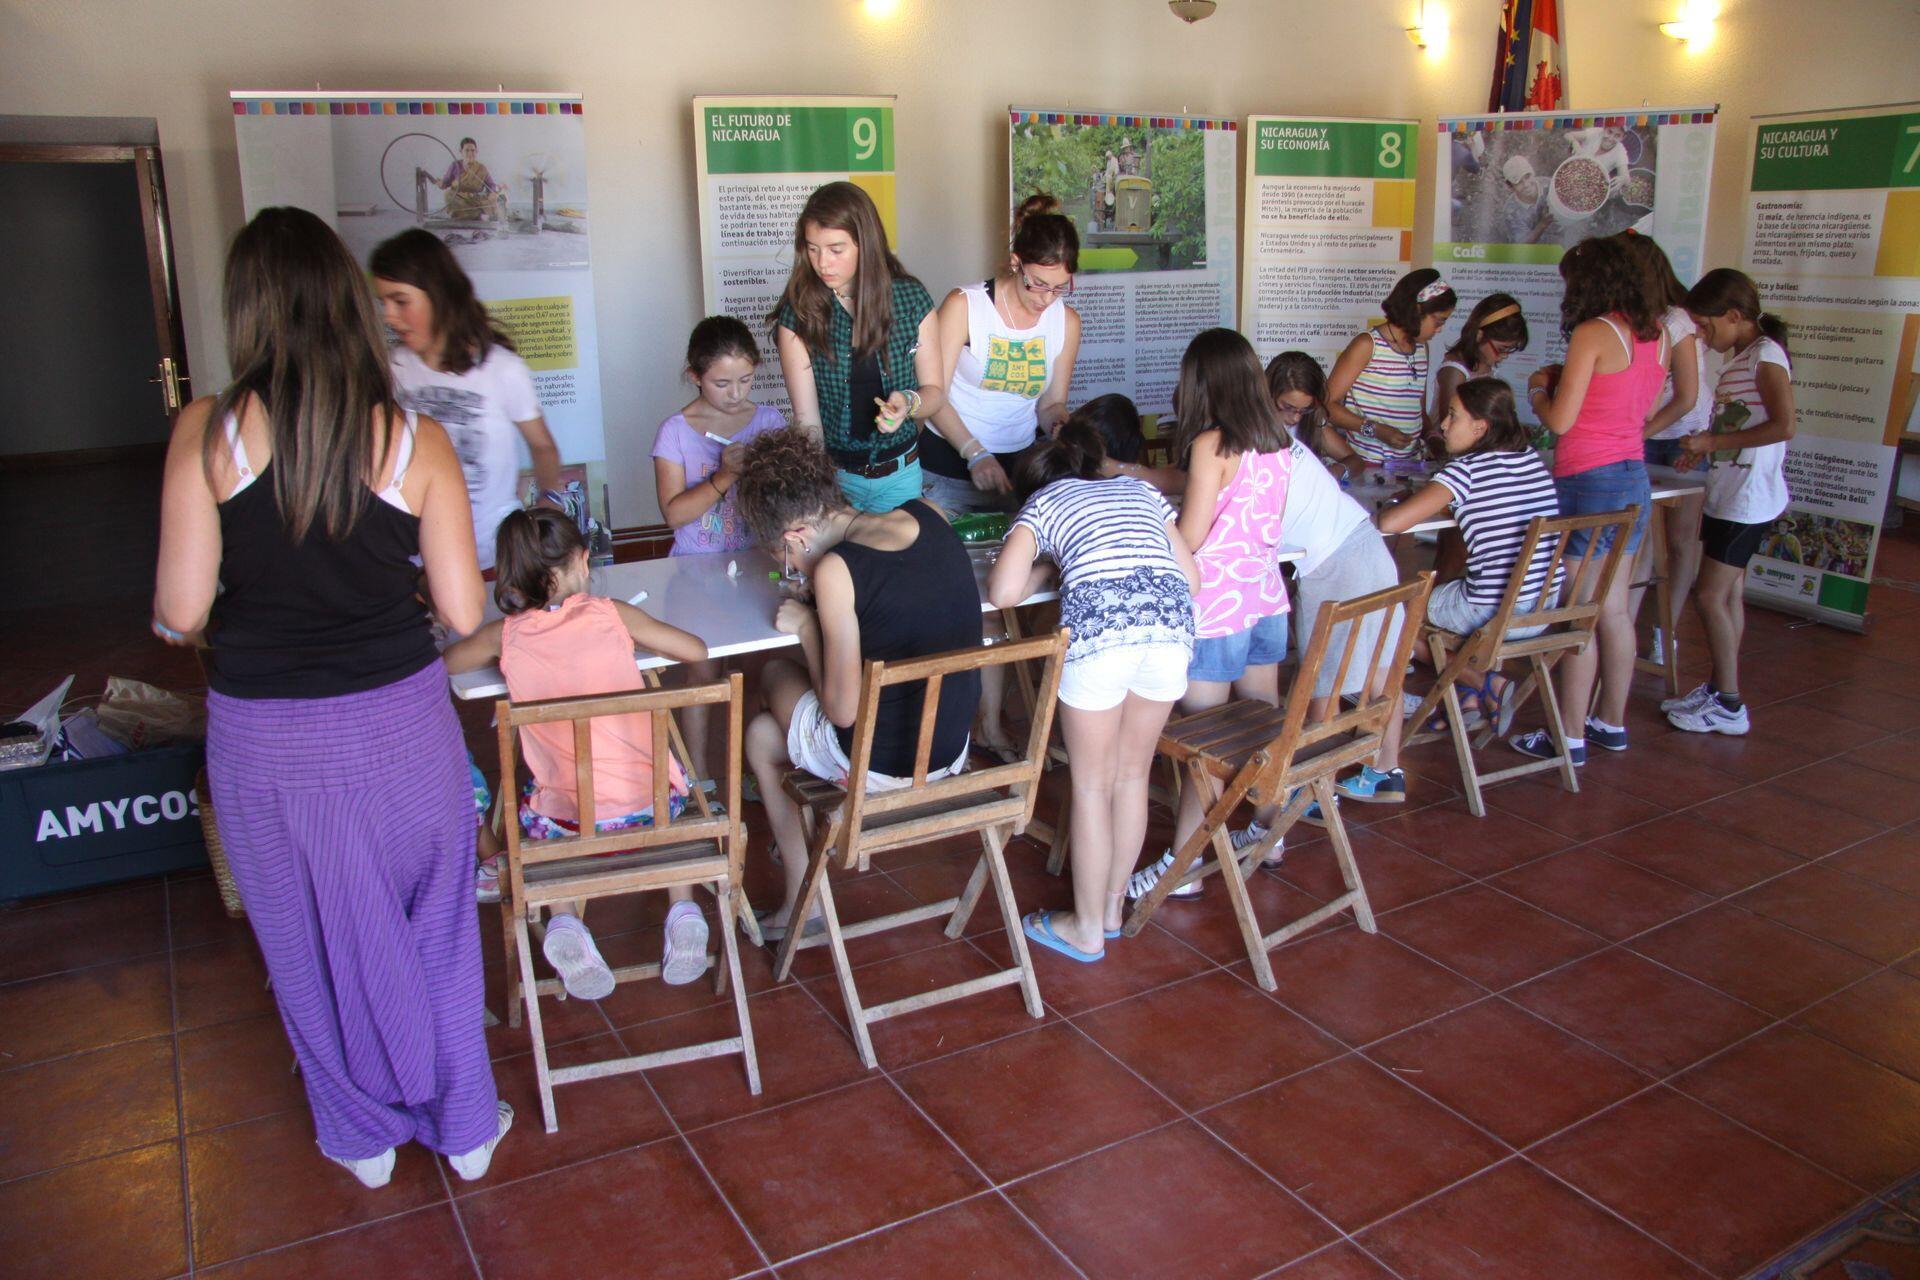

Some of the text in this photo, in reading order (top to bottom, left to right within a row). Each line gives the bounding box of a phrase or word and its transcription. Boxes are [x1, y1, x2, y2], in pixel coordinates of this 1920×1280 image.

[712, 114, 792, 127] EL FUTURO DE
[712, 129, 781, 142] NICARAGUA
[1261, 127, 1328, 138] NICARAGUA Y
[1762, 128, 1838, 144] NICARAGUA Y
[852, 117, 877, 161] 9
[1261, 138, 1330, 151] SU ECONOMÍA
[1902, 125, 1920, 173] 7
[1378, 131, 1402, 169] 8
[1760, 144, 1829, 160] SU CULTURA
[727, 185, 759, 194] principal
[1332, 185, 1361, 193] mejorado
[736, 195, 753, 203] país,
[1304, 192, 1334, 200] excepción
[719, 203, 769, 211] bastante más,
[1293, 199, 1323, 207] provocado
[1333, 207, 1363, 215] población
[1827, 213, 1859, 222] indígena,
[730, 221, 758, 230] podrían
[1821, 222, 1872, 231] nicaragüense.
[721, 230, 744, 238] líneas
[756, 229, 784, 238] trabajo
[1349, 234, 1394, 242] principalmente
[1767, 232, 1814, 240] nicaragüenses
[721, 239, 768, 247] continuación
[1349, 241, 1368, 249] países
[1833, 241, 1854, 250] plato:
[1800, 250, 1828, 258] frijoles,
[723, 268, 764, 277] Diversificar
[1309, 267, 1335, 275] proviene
[723, 278, 769, 286] sostenibles.
[724, 295, 756, 305] Asegurar
[1797, 295, 1833, 303] tradiciones
[1867, 298, 1888, 307] según
[724, 305, 751, 314] lleguen
[1257, 303, 1283, 311] madera)
[1817, 334, 1856, 343] Güegüense.
[1854, 357, 1884, 366] guitarra
[545, 373, 575, 383] productos
[1808, 381, 1864, 393] española (polcas
[1815, 410, 1875, 424] tradición indígena,
[1814, 453, 1878, 469] Güegüense, sobre
[1814, 462, 1848, 475] indígenas
[1784, 466, 1845, 482] Darío, creador del
[1814, 480, 1876, 496] sobresalen autores
[1814, 489, 1869, 504] Gioconda Belli.
[1804, 496, 1835, 507] Ramírez.
